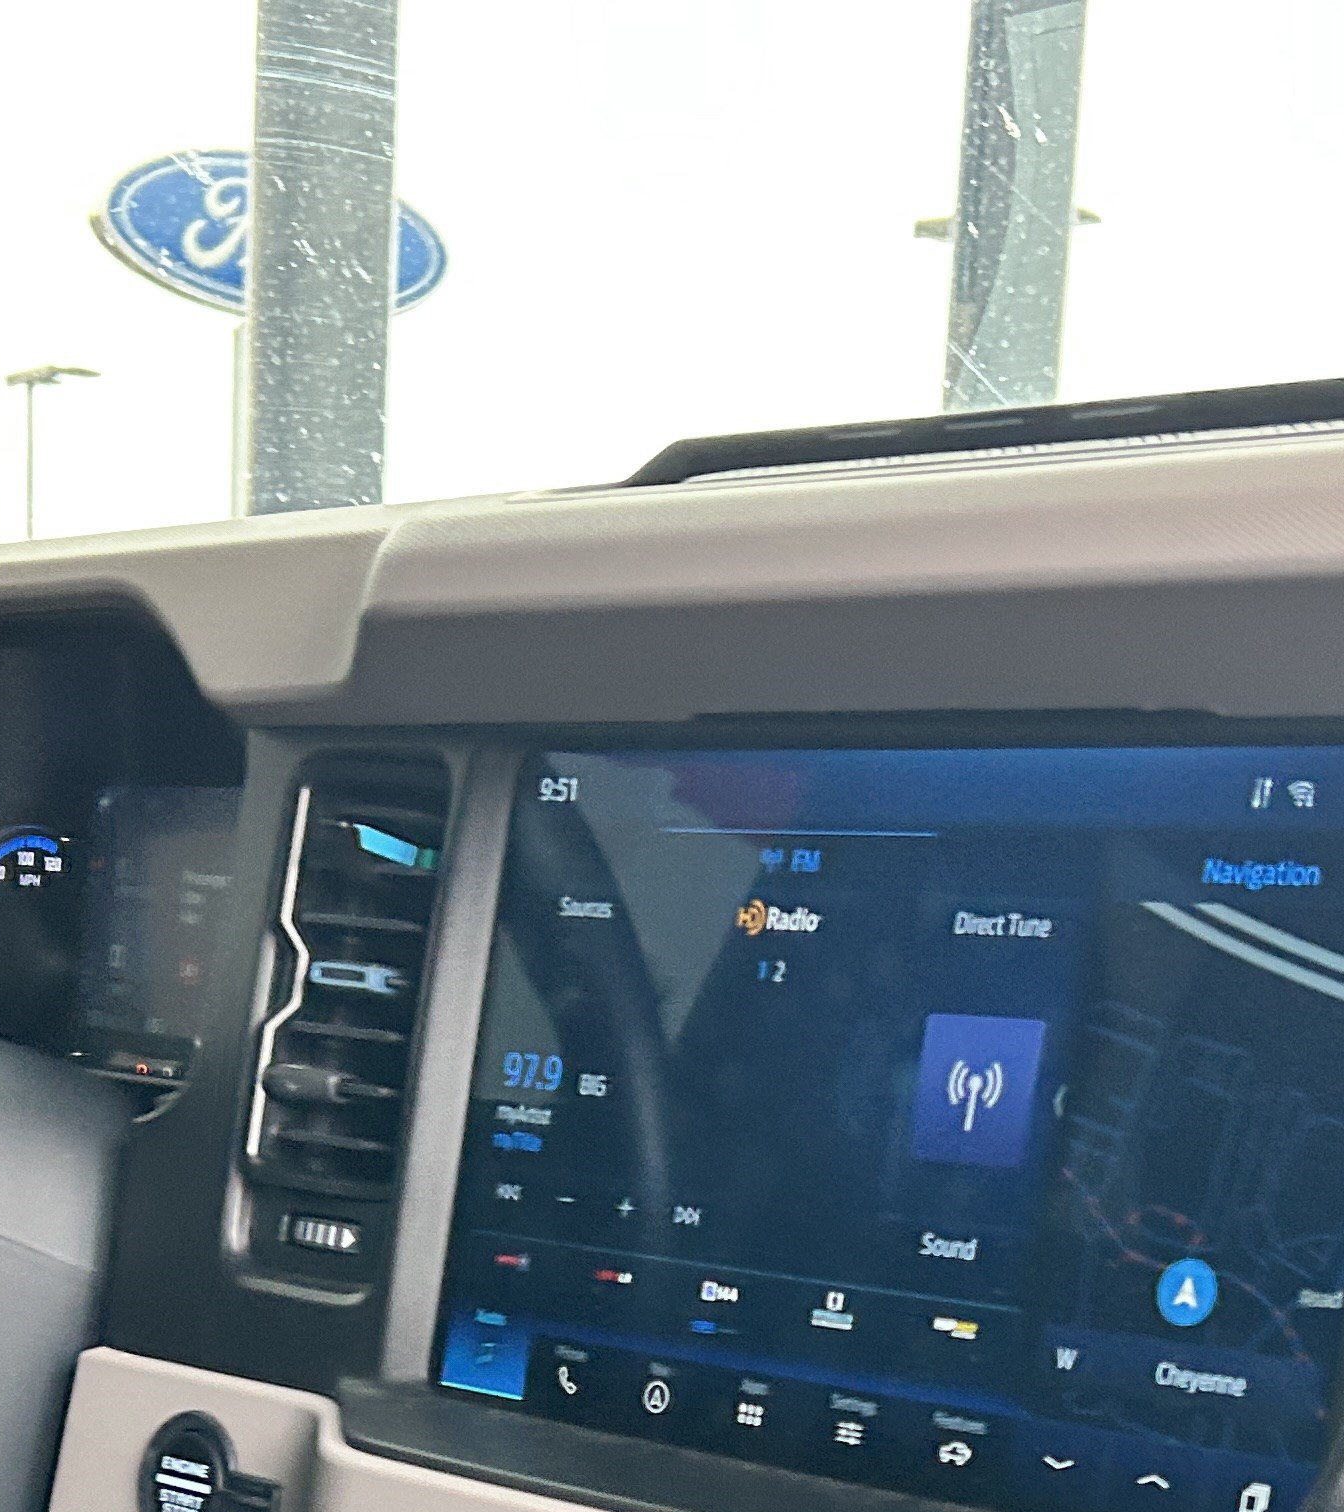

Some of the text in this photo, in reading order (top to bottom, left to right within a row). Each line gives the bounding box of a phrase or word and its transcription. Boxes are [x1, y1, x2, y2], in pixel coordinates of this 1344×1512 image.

[1203, 858, 1322, 890] Navigation
[953, 912, 1054, 939] Direct Tune
[772, 959, 787, 982] 2
[503, 1051, 564, 1092] 97.9
[919, 1231, 978, 1262] Sound
[1056, 1346, 1078, 1370] W
